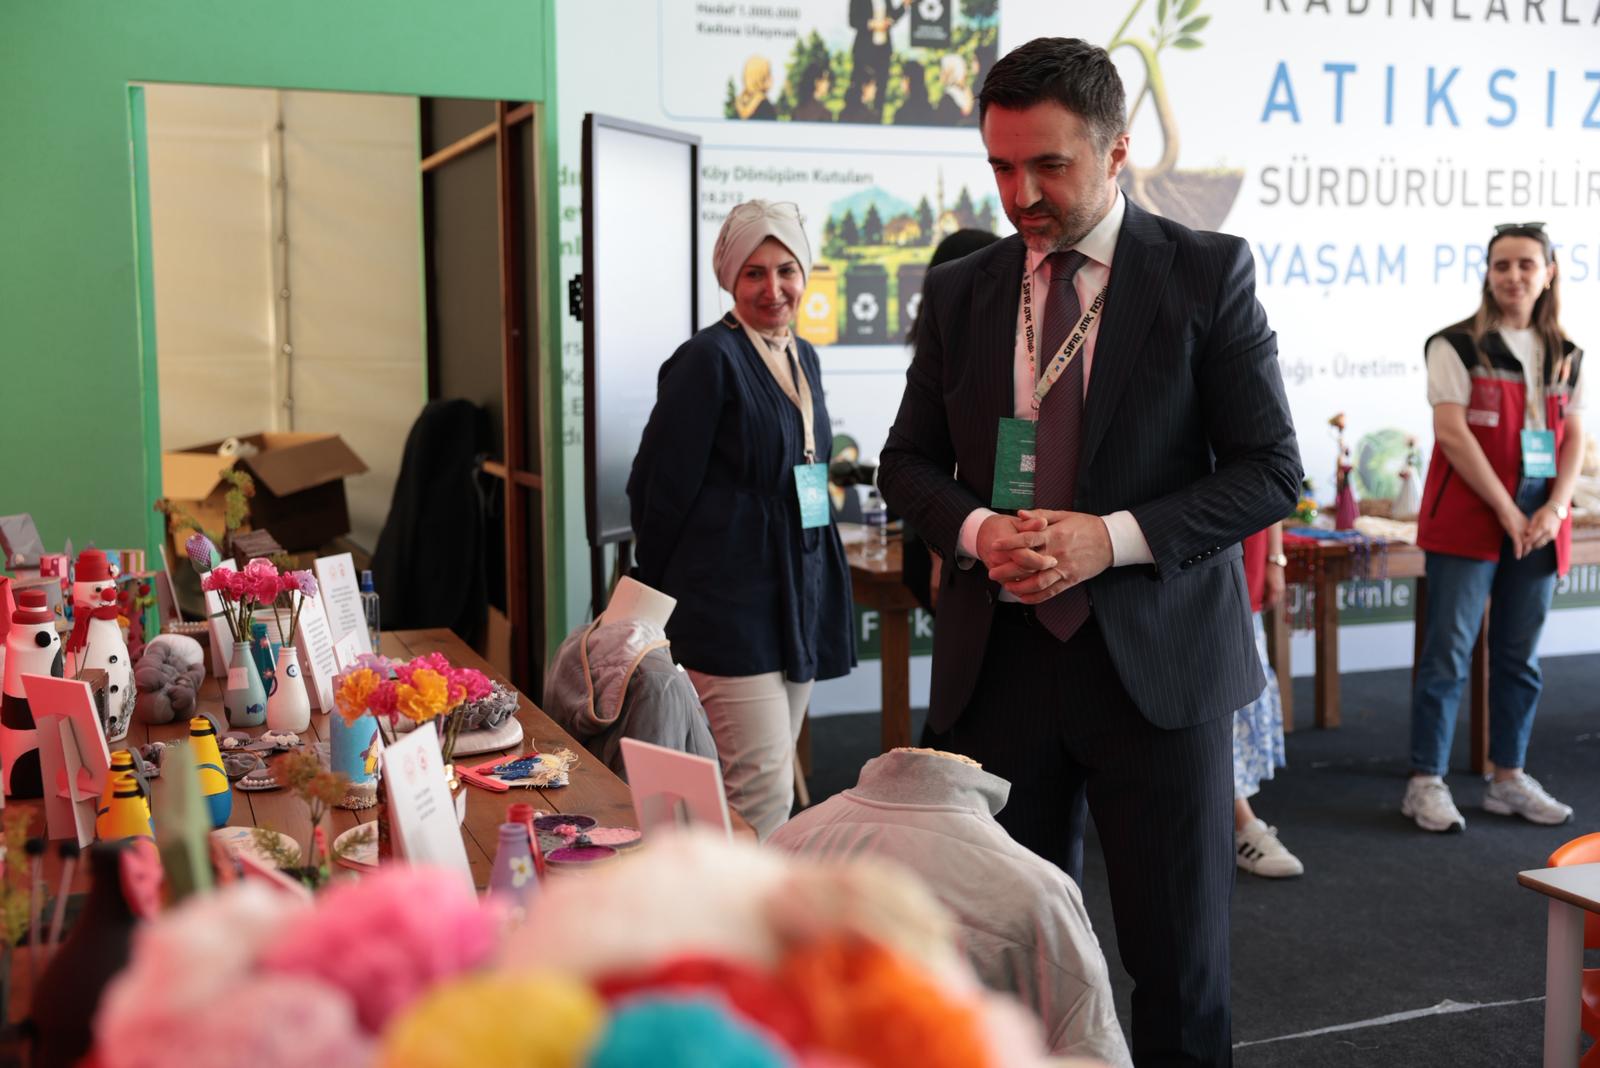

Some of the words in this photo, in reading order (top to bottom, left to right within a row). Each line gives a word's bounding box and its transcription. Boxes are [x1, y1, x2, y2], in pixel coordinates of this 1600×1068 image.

[1257, 242, 1407, 298] YAŞAM
[1063, 332, 1083, 358] SIFIR
[1079, 313, 1095, 334] ATIK
